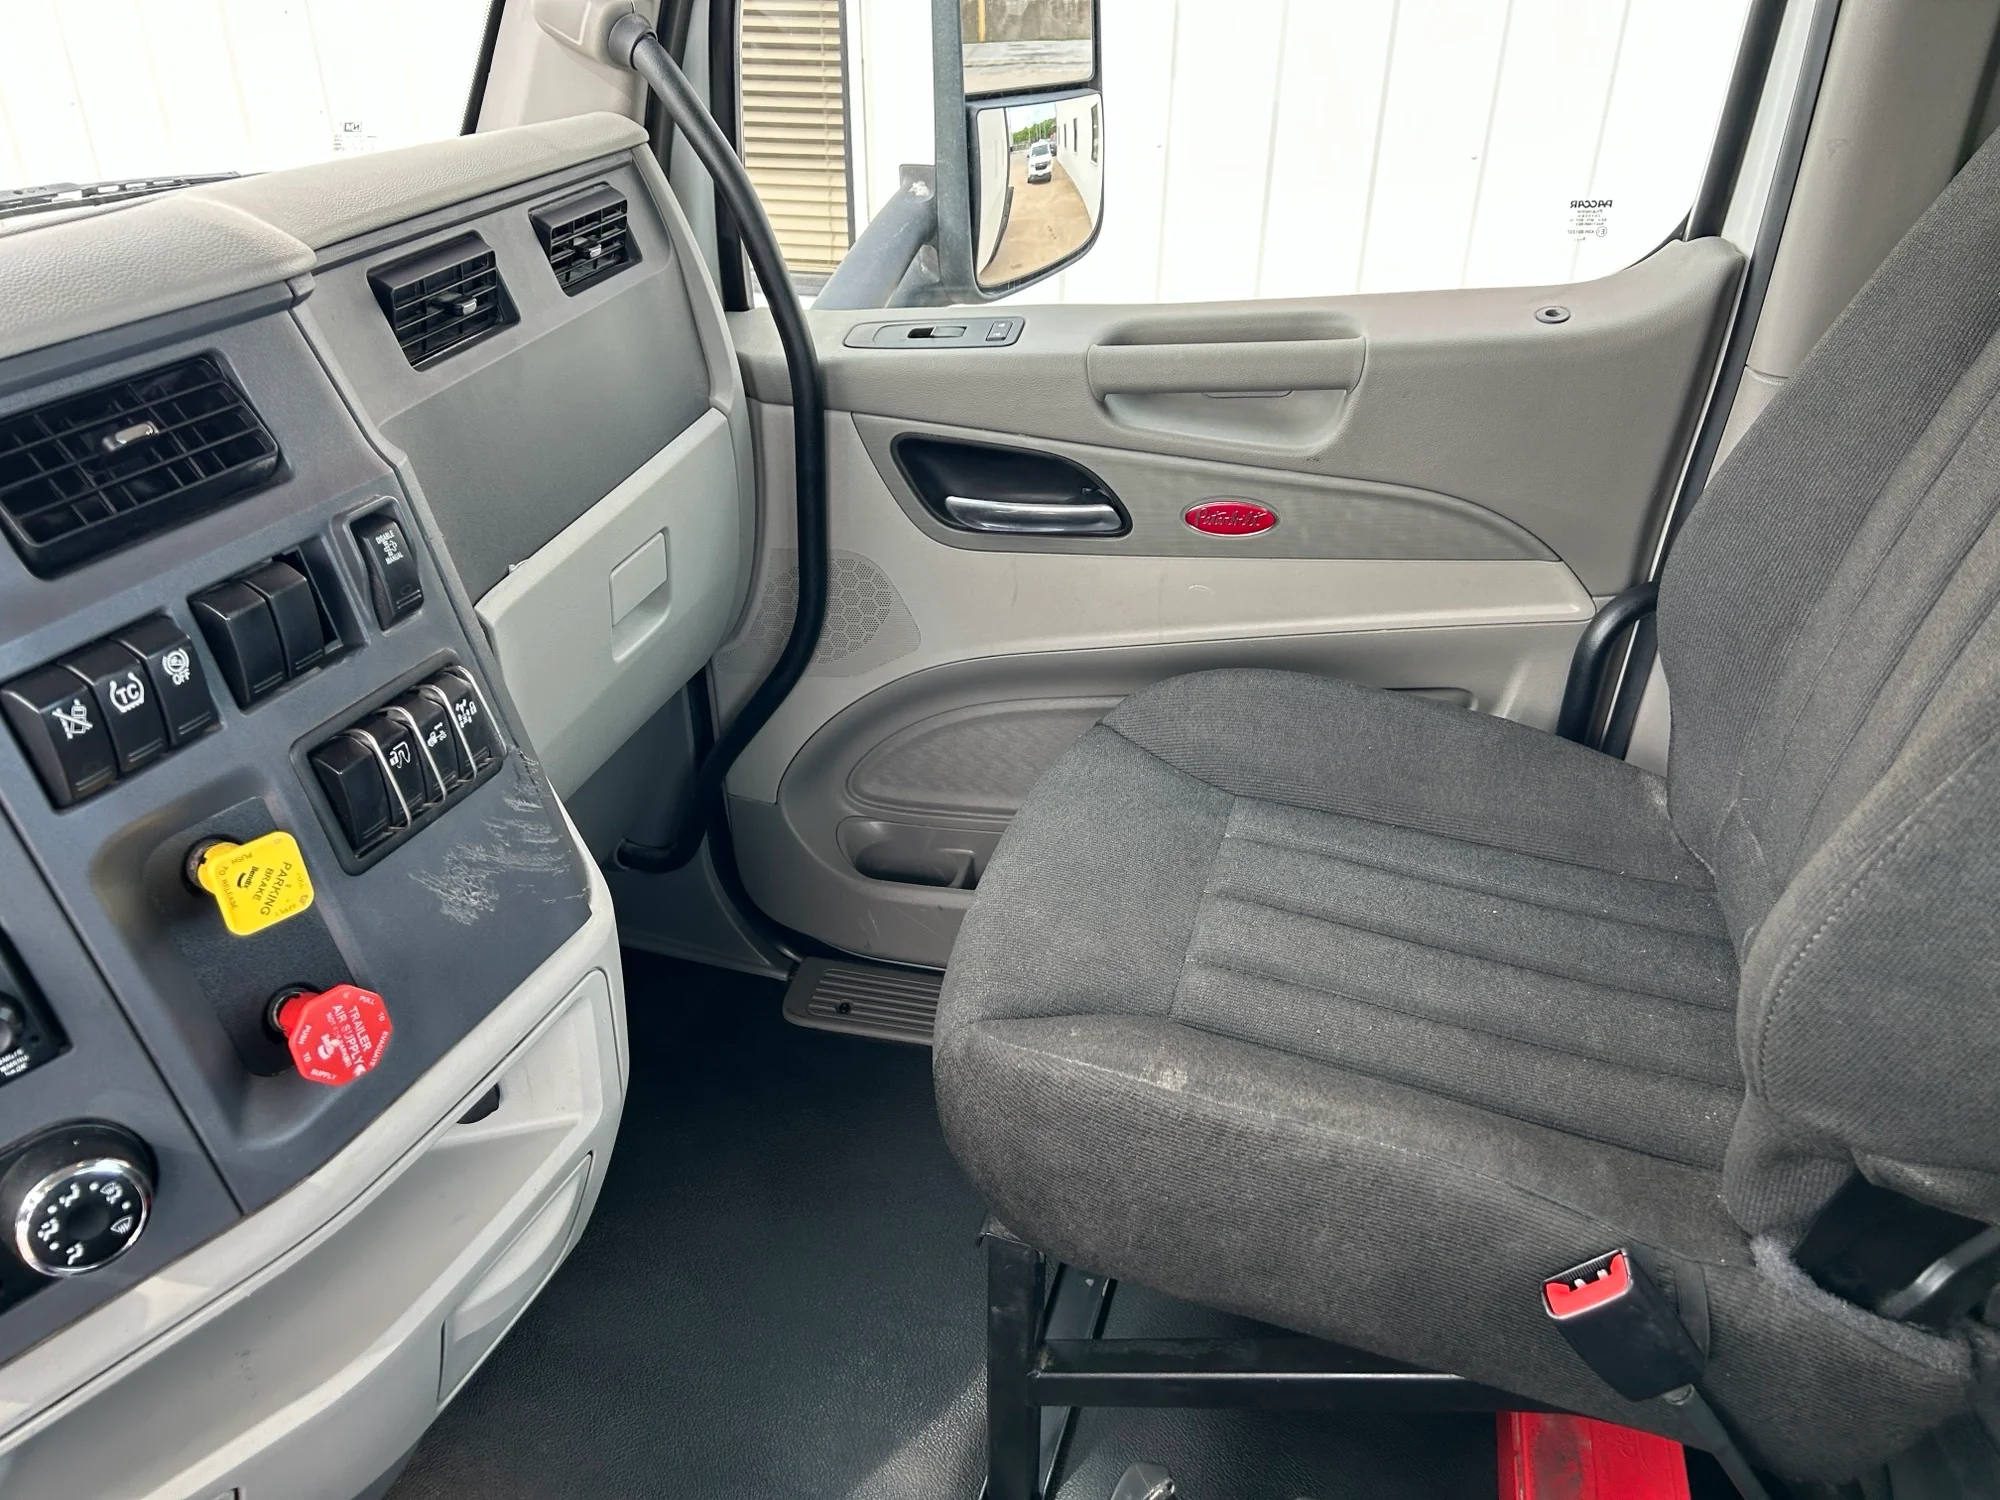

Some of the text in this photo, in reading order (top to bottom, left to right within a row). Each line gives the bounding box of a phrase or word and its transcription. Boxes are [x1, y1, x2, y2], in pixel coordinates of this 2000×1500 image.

[172, 668, 190, 685] OFF
[116, 683, 139, 704] TC
[231, 852, 253, 865] PUSH
[222, 879, 239, 911] RELEASE
[252, 868, 274, 901] BRAKE
[260, 861, 292, 916] PARKING
[326, 1012, 336, 1026] NOT
[332, 1005, 364, 1065] AIR SUPPLY
[349, 1005, 372, 1052] TRAILER
[359, 995, 389, 1067] PULL TO EVACUATE
[298, 1024, 337, 1080] PUSH TO SUPPLY
